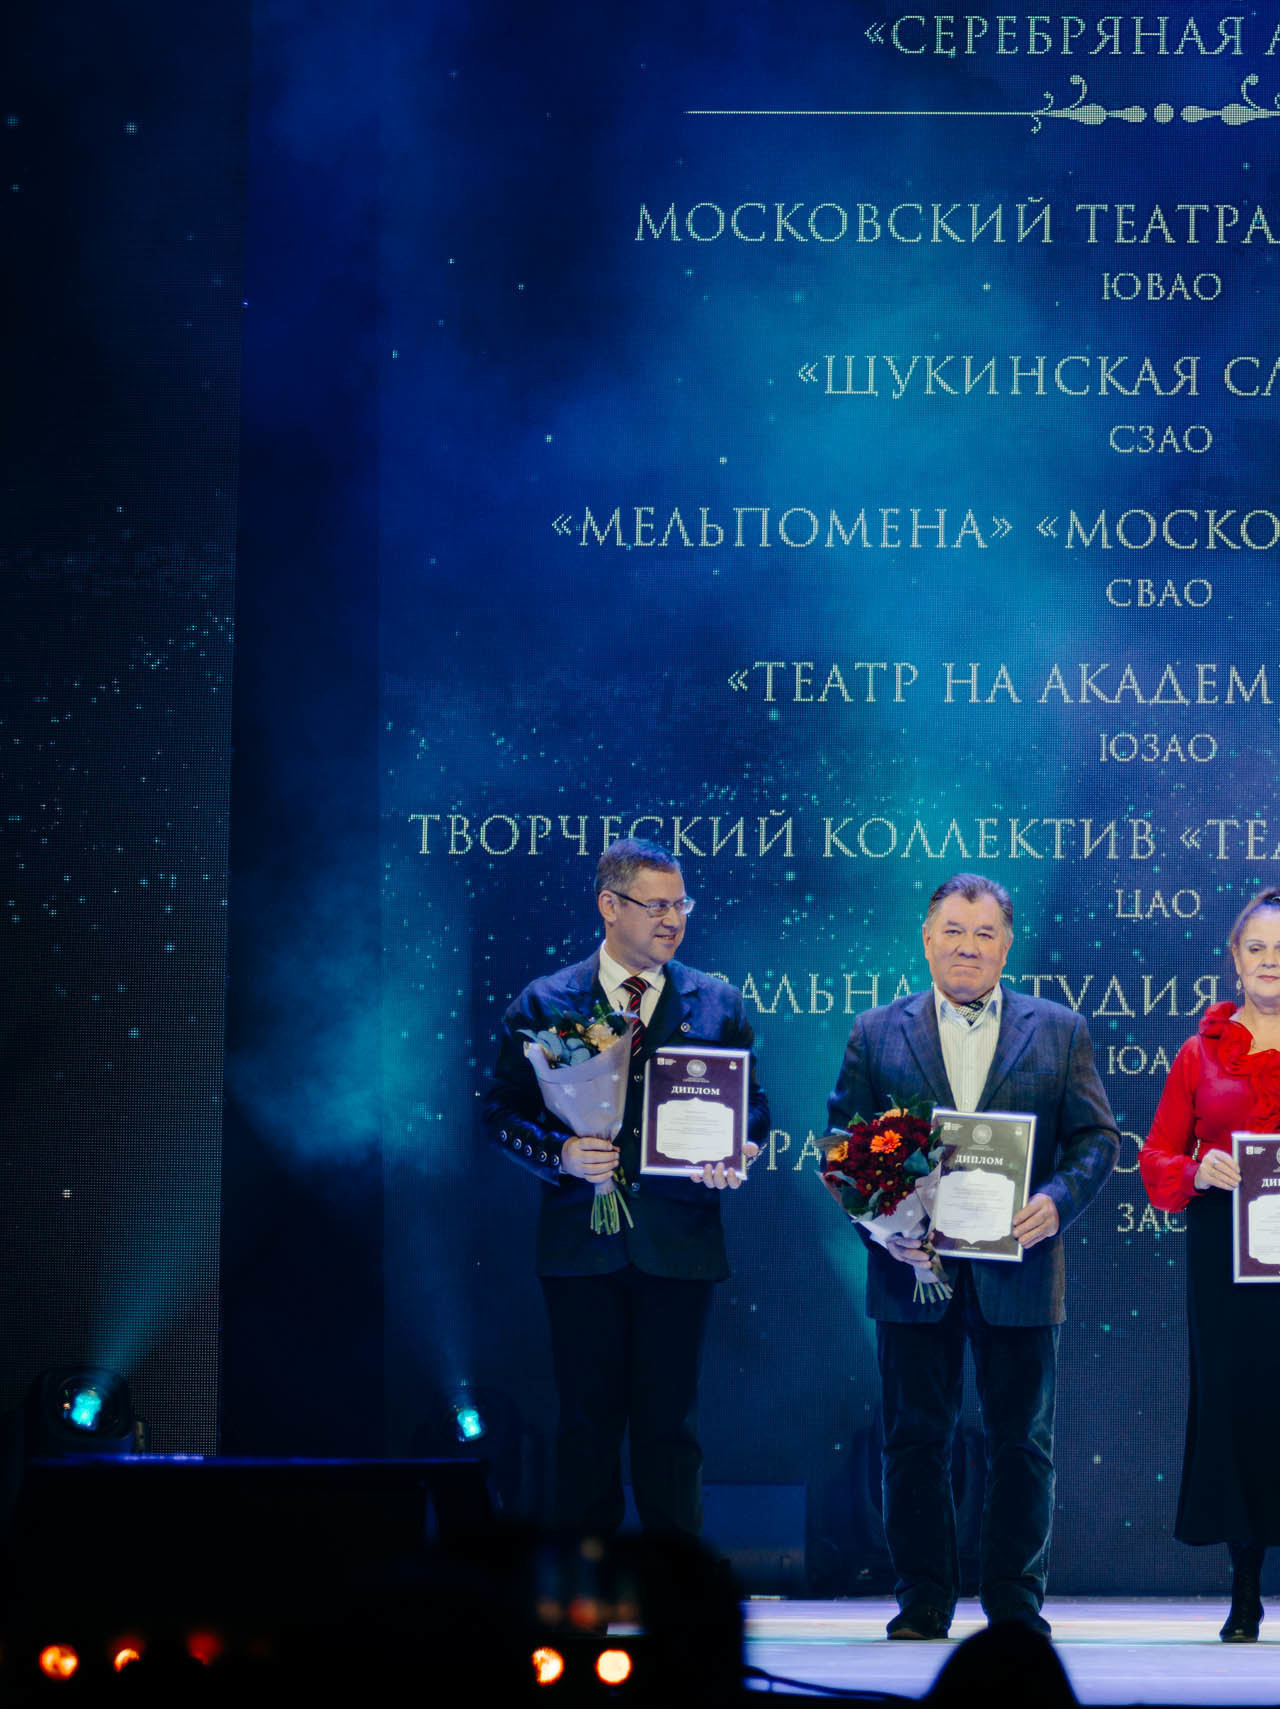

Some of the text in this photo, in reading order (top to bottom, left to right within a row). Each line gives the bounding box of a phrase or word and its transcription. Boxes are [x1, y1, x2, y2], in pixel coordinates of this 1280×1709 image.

[864, 14, 1245, 56] «СЕРЕБРЯНАЯ
[635, 196, 1053, 244] МОСКОВСКИЙ
[1102, 272, 1222, 301] ЮВАО
[797, 355, 1202, 400] «ЩУКИНСКАЯ
[1109, 424, 1214, 454] СЗАО
[551, 506, 1013, 550] «МЕЛЬПОМЕНА»
[1105, 578, 1213, 608] СВАО
[728, 660, 918, 703] «ТЕАТР
[943, 662, 1022, 704] НА
[1099, 733, 1218, 763] ЮЗАО
[822, 816, 1157, 860] КОЛЛЕКТИВ
[1115, 888, 1201, 920] ЦАО
[1000, 974, 1220, 1017] ТУДИЯ
[1106, 1045, 1180, 1074] ЮА
[671, 1085, 721, 1096] ДИПЛОМ
[954, 1154, 1004, 1166] ДИПЛОМ
